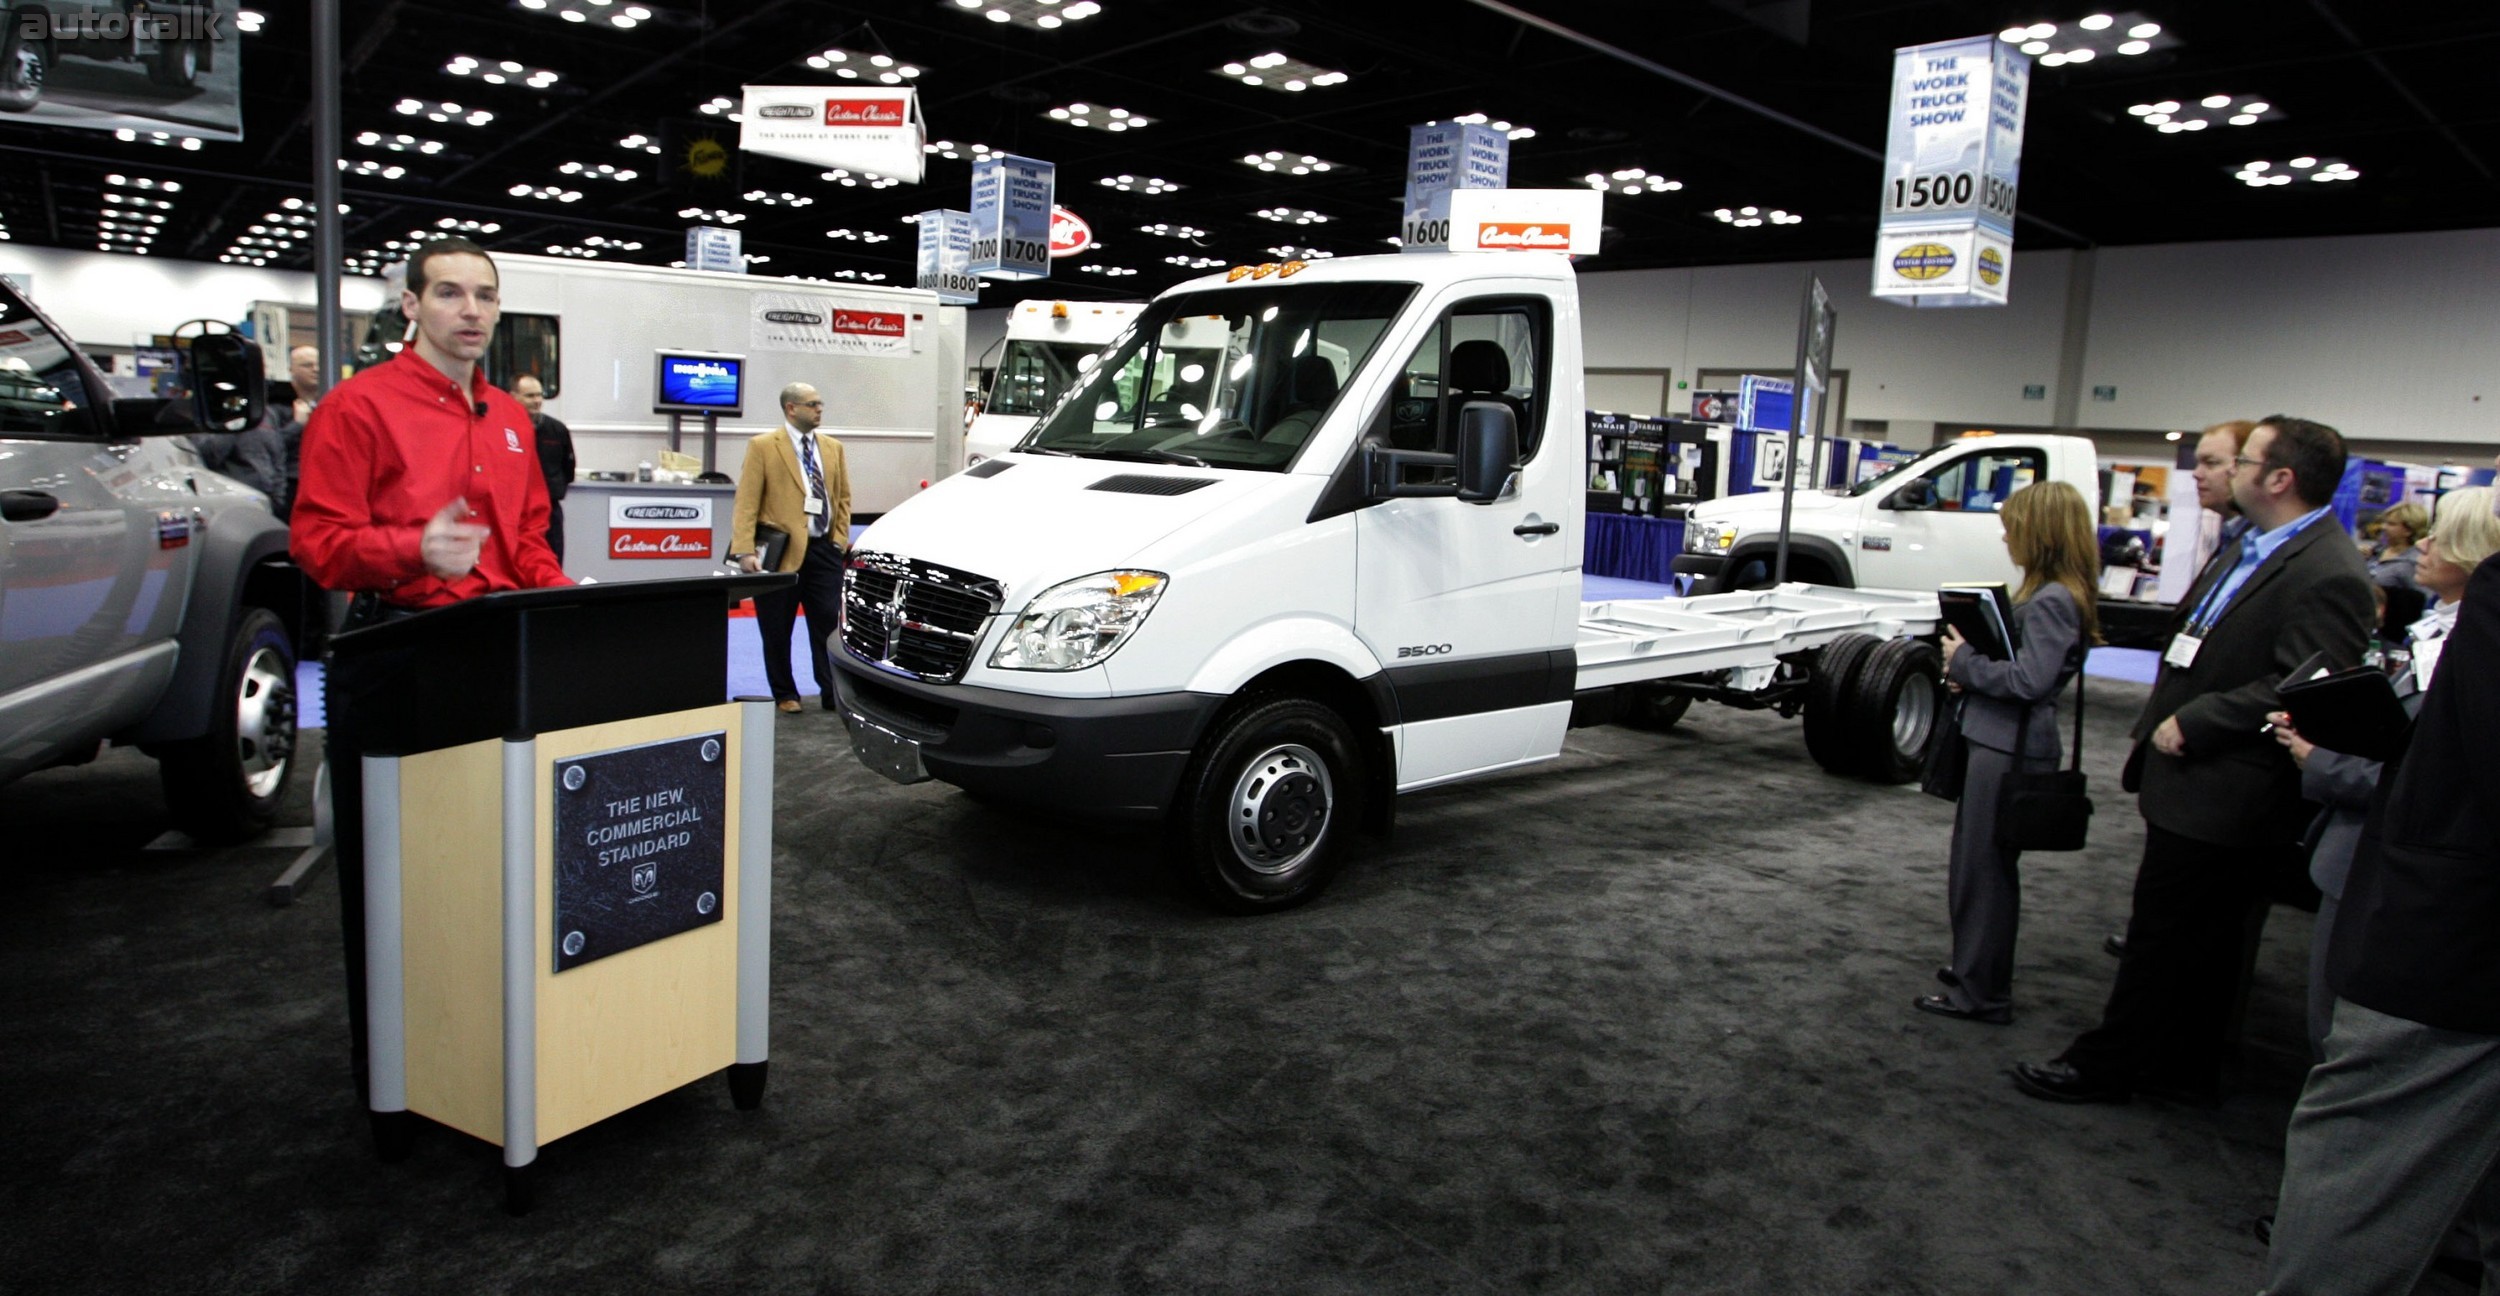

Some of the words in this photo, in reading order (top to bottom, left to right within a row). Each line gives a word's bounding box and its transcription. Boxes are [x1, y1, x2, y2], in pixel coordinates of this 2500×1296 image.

[1926, 57, 1958, 72] THE
[1912, 73, 1969, 91] WORK
[1910, 91, 1968, 109] TRUCK
[1910, 109, 1965, 127] SHOW
[1427, 133, 1444, 144] THE
[1478, 135, 1494, 149] THE
[1418, 146, 1450, 158] WORK
[1471, 148, 1499, 163] WORK
[1020, 167, 1037, 178] THE
[1417, 159, 1449, 171] TRUCK
[1470, 161, 1498, 176] TRUCK
[1013, 178, 1043, 189] WORK
[1417, 173, 1448, 185] SHOW
[1470, 174, 1497, 188] SHOW
[1012, 188, 1042, 200] TRUCK
[1895, 173, 1972, 209] 1500
[1983, 173, 2014, 216] 1500
[1012, 199, 1041, 211] SHOW
[1407, 220, 1450, 244] 1600
[972, 239, 998, 260] 1700
[1005, 239, 1047, 263] 1700
[943, 273, 976, 292] 1800
[1591, 422, 1625, 430] VANAIR
[1638, 422, 1663, 431] VANAIR
[626, 507, 697, 518] FREIGHTLINER
[614, 534, 658, 553] Custom
[660, 534, 706, 553] Chassis
[1397, 643, 1452, 658] 3500
[606, 796, 641, 818] THE
[646, 787, 684, 810] NEW
[587, 807, 702, 846] COMMERCIAL
[598, 831, 691, 867] STANDARD
